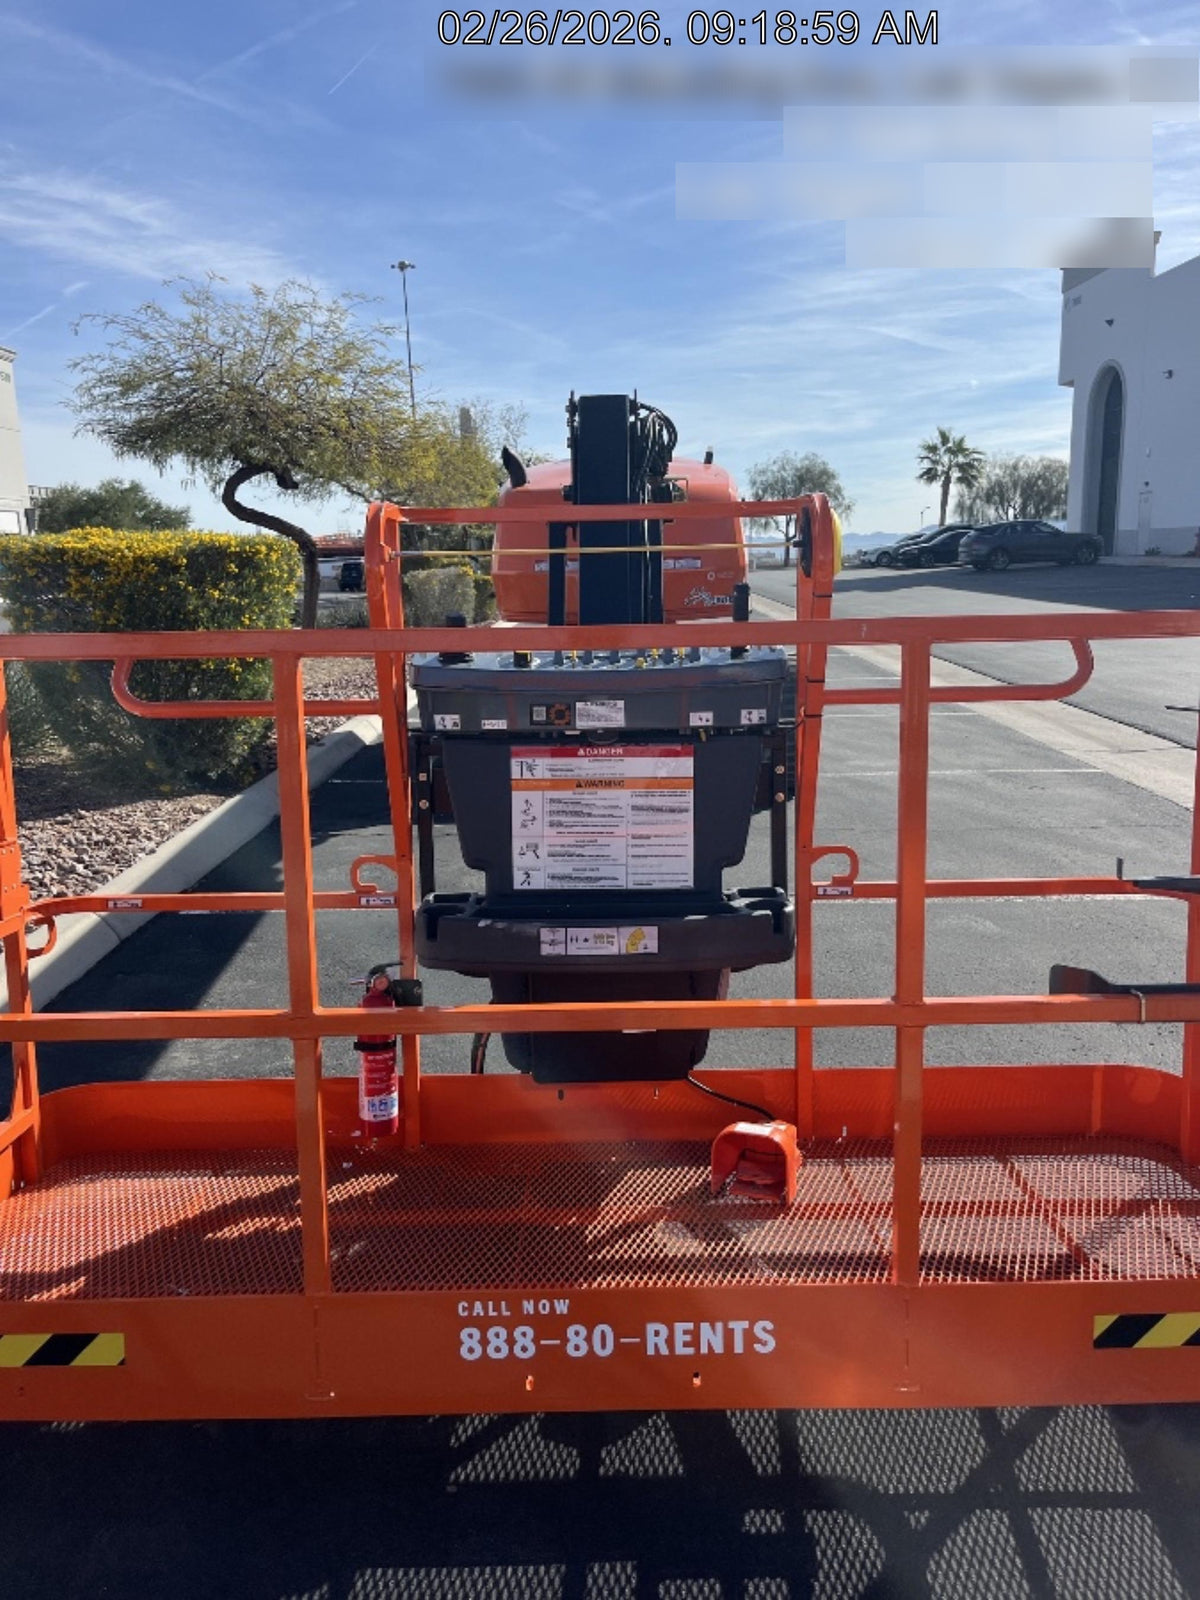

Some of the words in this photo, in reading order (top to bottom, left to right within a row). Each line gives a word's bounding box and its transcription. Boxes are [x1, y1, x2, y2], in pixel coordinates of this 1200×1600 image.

[457, 1300, 511, 1317] CALL
[522, 1299, 570, 1315] NOW
[459, 1320, 776, 1361] 888-80-RENTS
